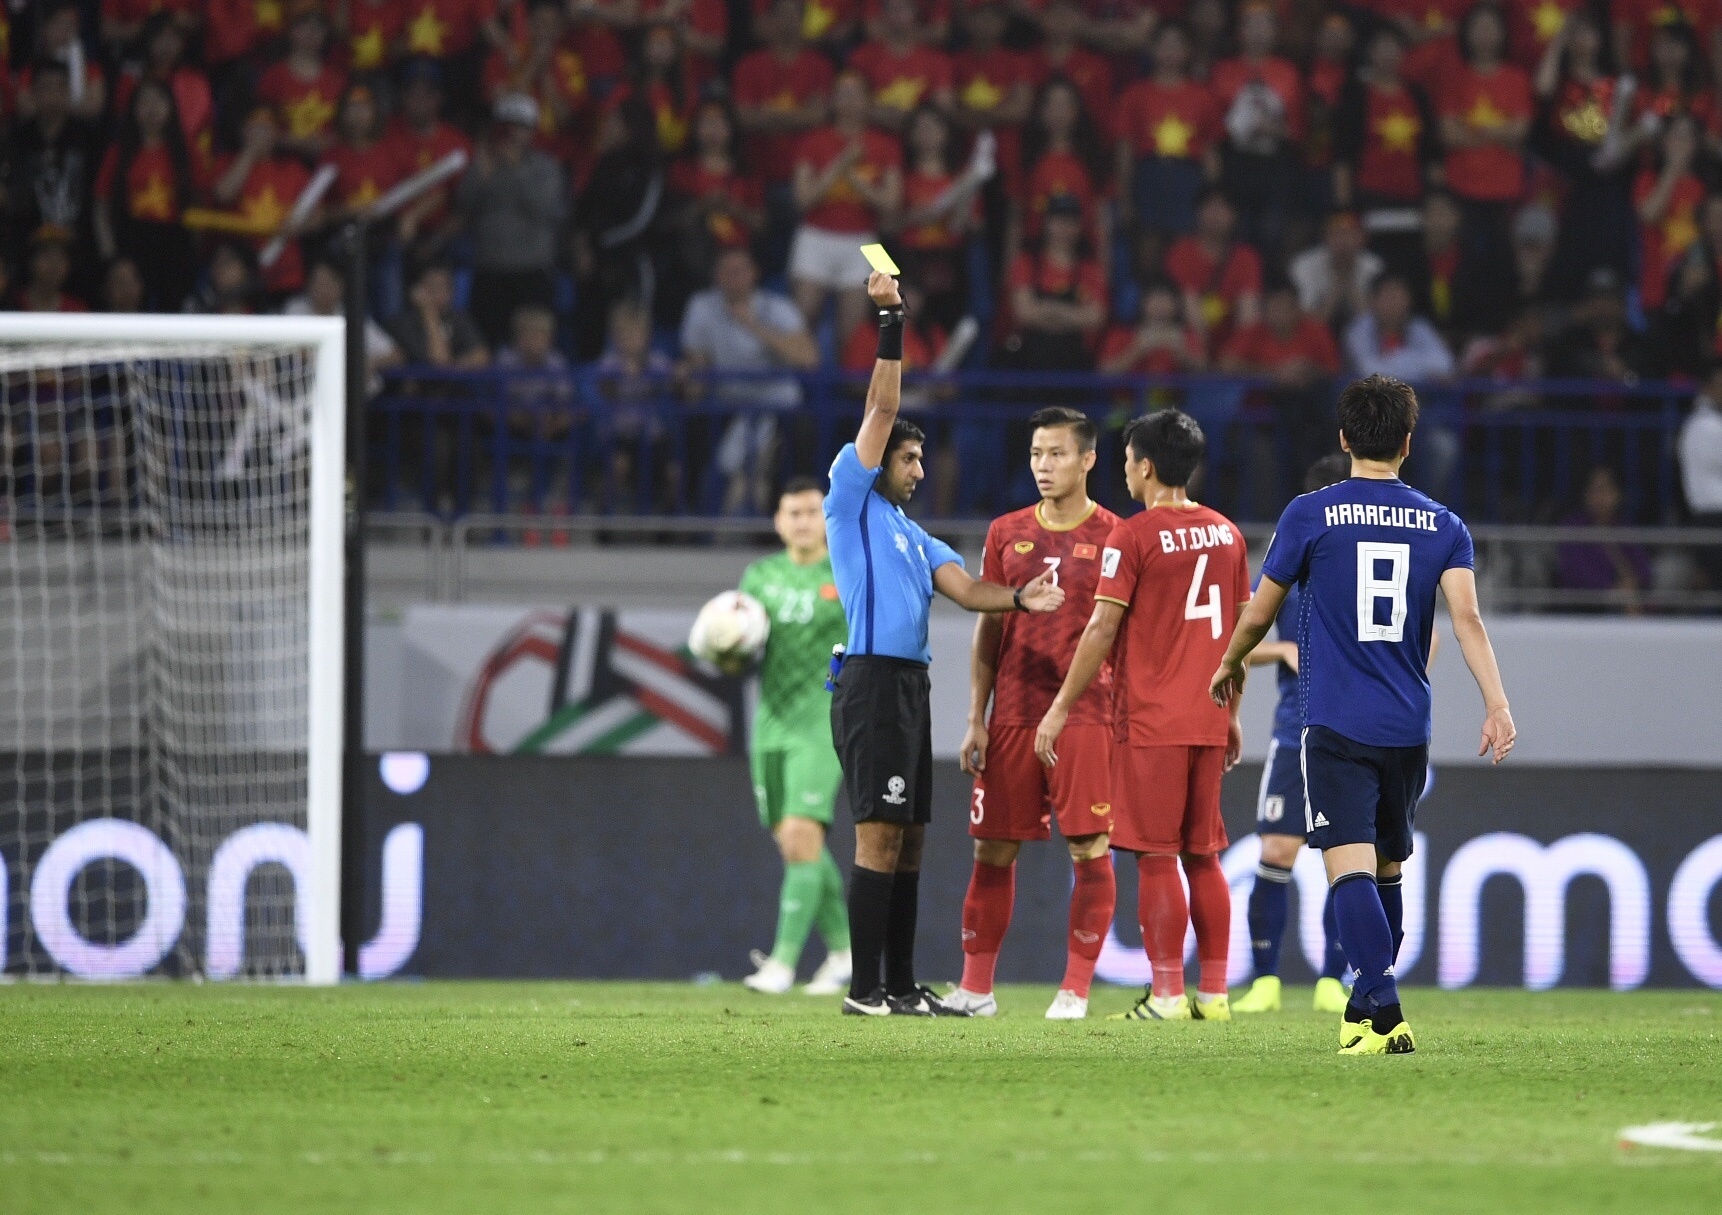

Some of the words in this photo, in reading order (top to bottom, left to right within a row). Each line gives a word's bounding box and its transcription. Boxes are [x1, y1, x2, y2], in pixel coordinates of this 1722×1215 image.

[1325, 504, 1437, 531] HARAGUCHI
[1159, 524, 1233, 553] B.T.DUNG
[778, 588, 815, 624] 23
[1185, 553, 1222, 640] 4
[1357, 542, 1410, 642] 8
[970, 787, 985, 825] 3
